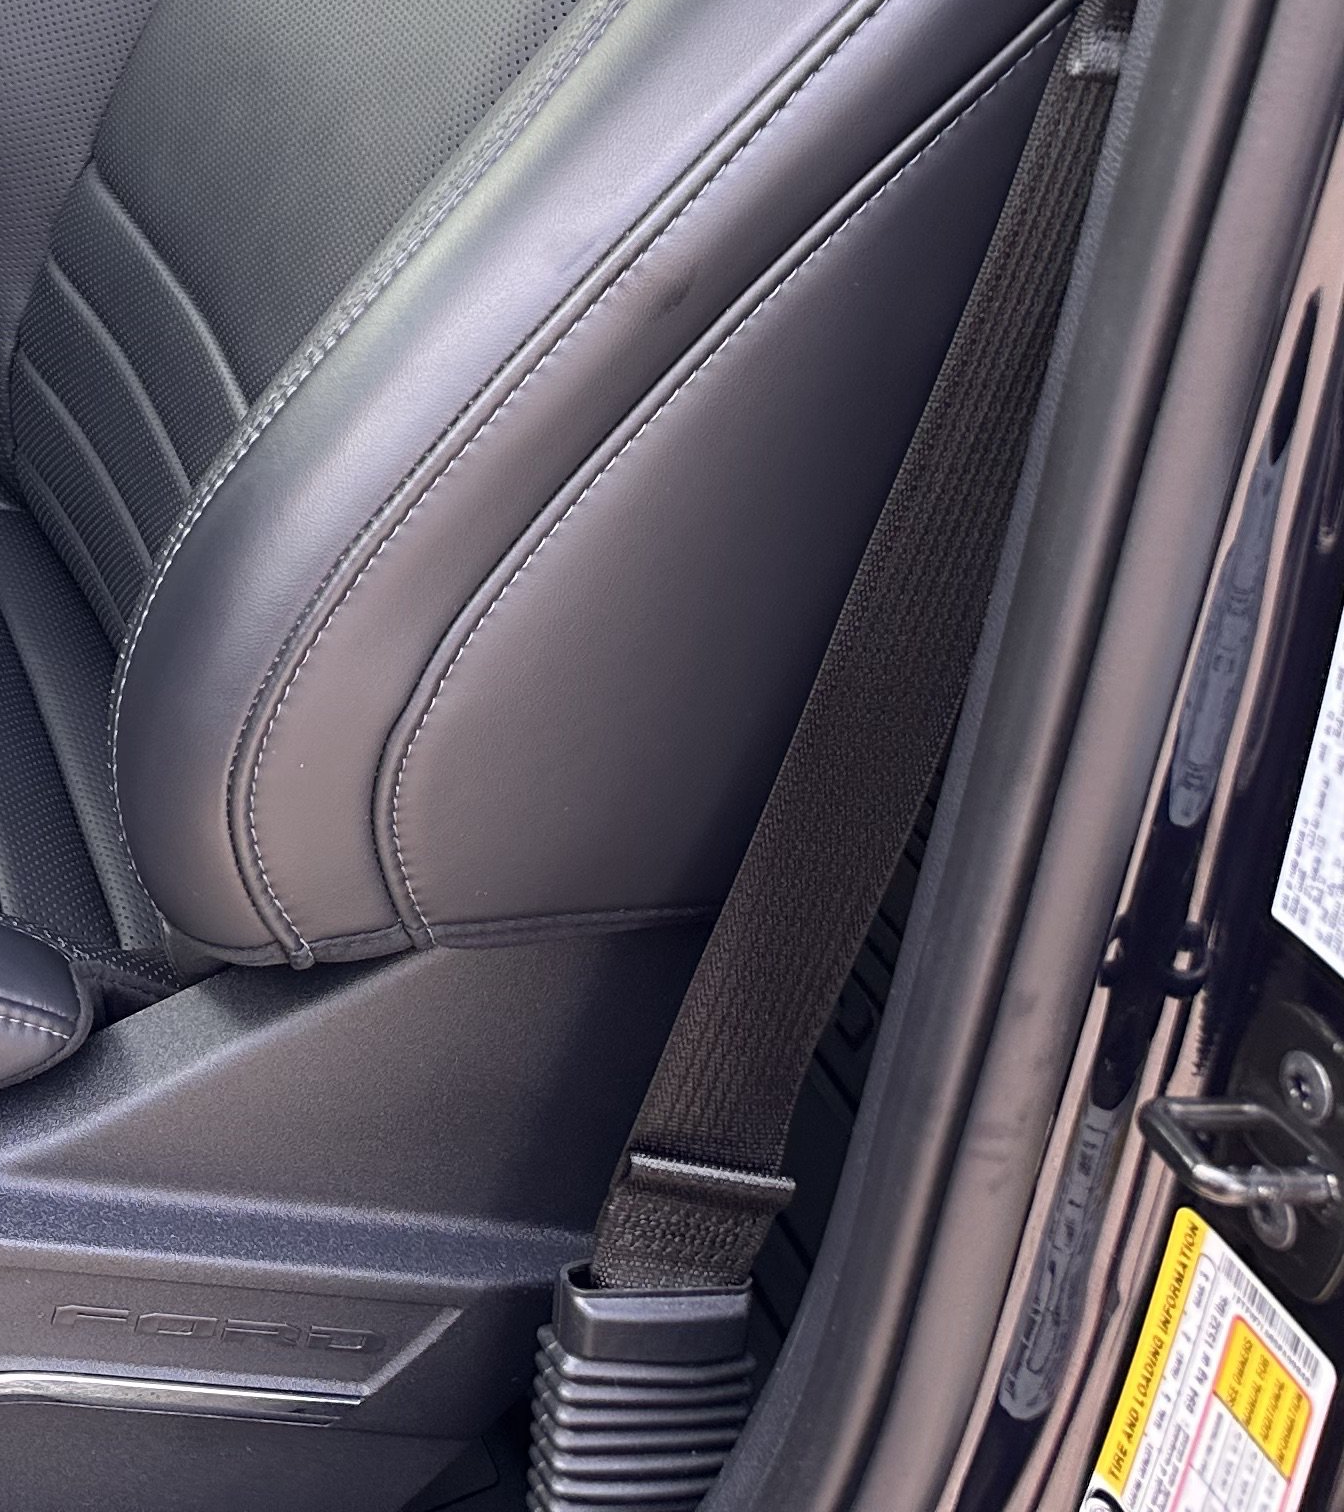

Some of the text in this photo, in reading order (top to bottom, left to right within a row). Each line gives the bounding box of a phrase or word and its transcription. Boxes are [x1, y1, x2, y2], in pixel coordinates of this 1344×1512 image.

[50, 1303, 387, 1351] FORD
[1107, 1221, 1199, 1482] TIRE AND LOADING INFORMATION
